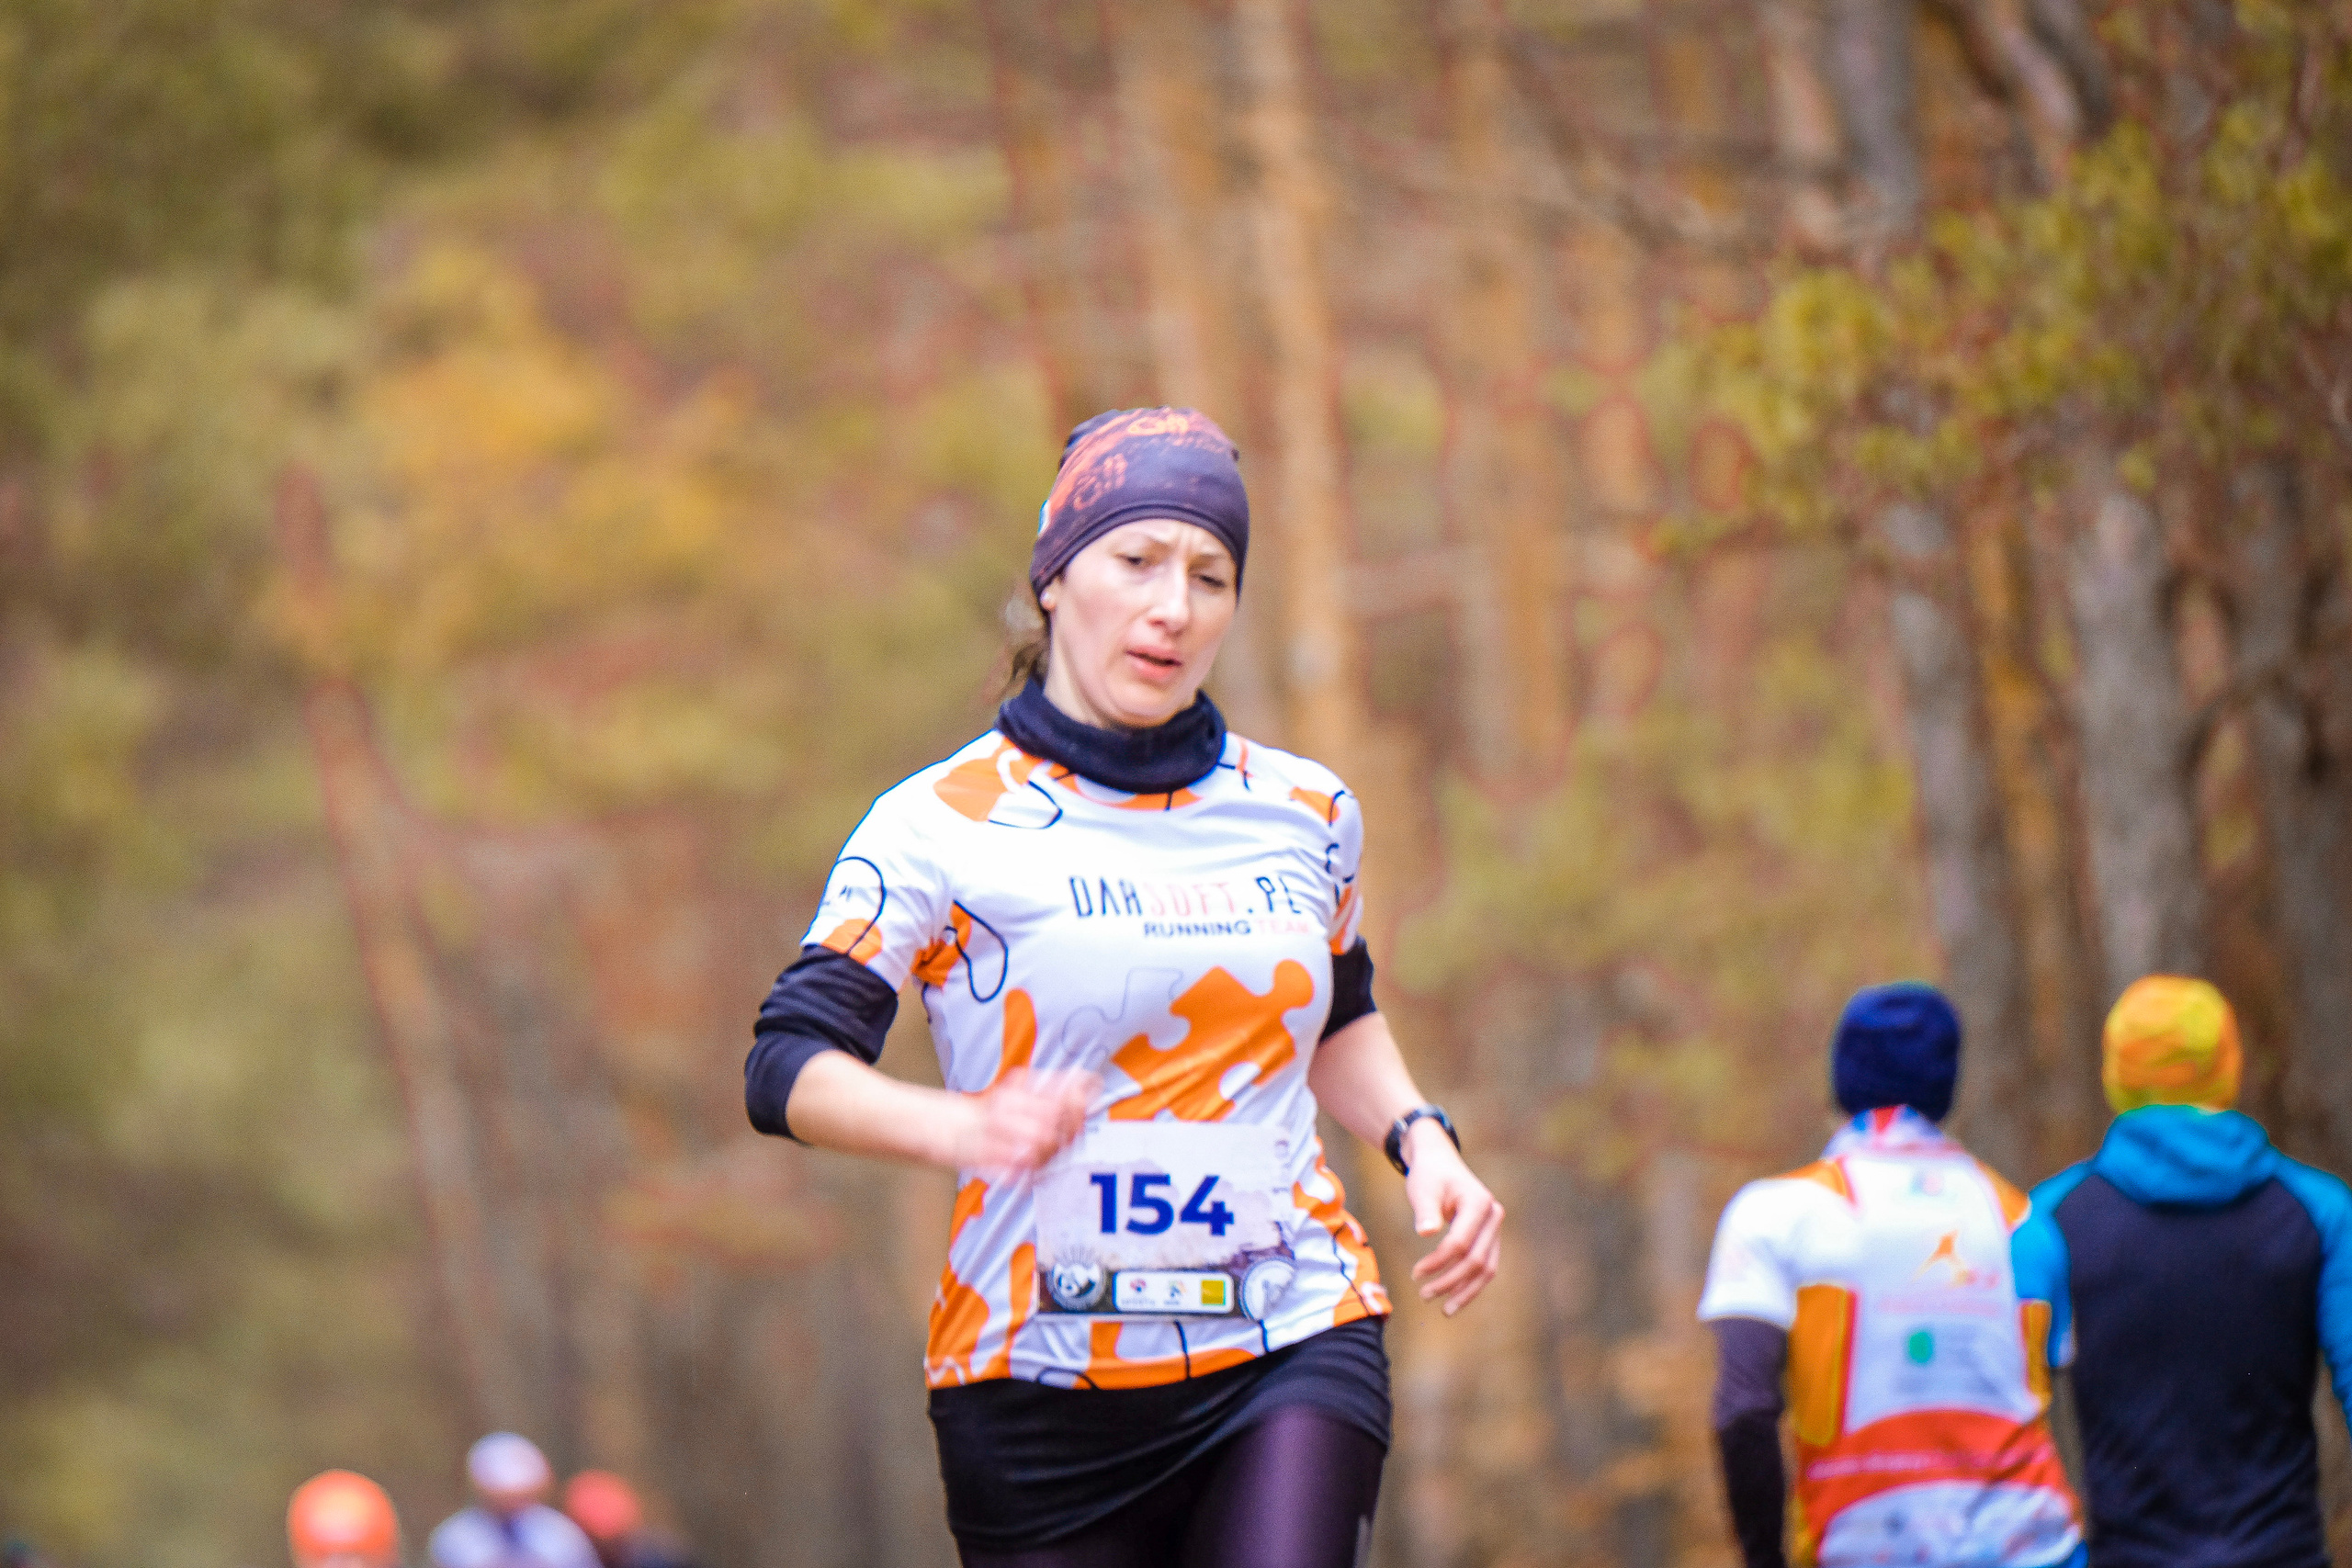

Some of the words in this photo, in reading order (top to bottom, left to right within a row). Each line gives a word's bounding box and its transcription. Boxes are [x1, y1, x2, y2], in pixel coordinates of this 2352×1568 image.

[1143, 919, 1252, 938] RUNNING
[1256, 919, 1310, 935] TEAM
[1090, 1172, 1235, 1235] 154
